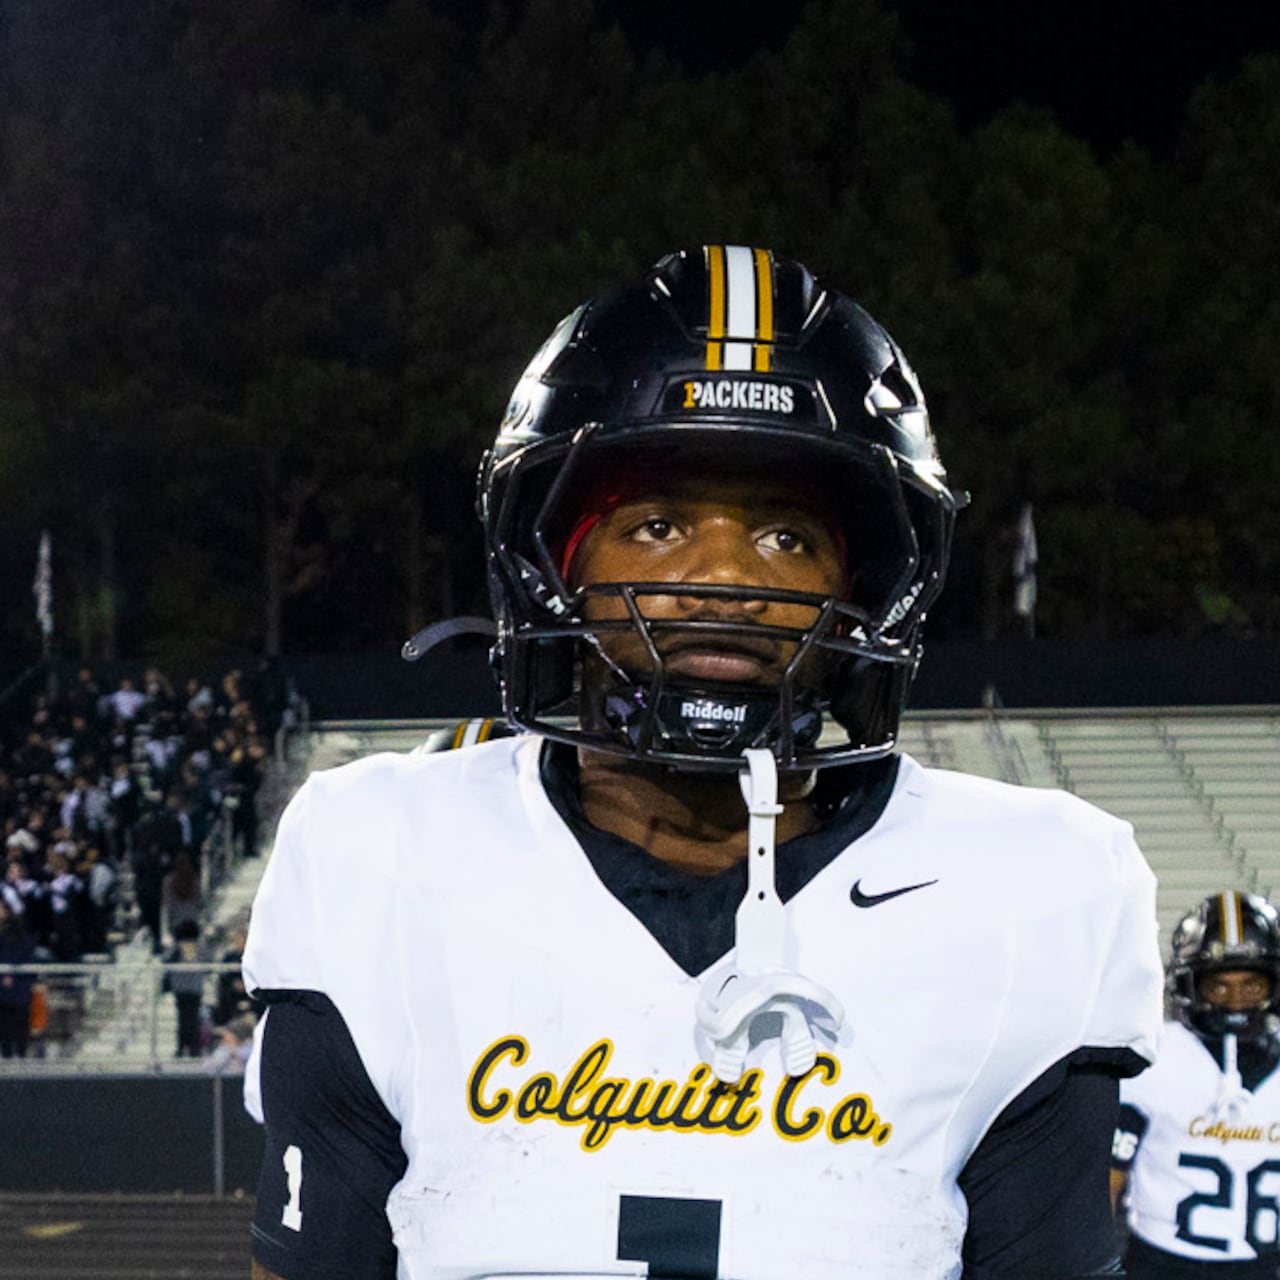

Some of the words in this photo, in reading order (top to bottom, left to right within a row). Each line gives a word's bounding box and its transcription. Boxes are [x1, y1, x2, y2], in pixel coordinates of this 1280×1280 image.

[681, 699, 748, 722] Riddell
[467, 1034, 762, 1153] Colquitt
[771, 1052, 893, 1147] Co.
[281, 1144, 303, 1232] 1
